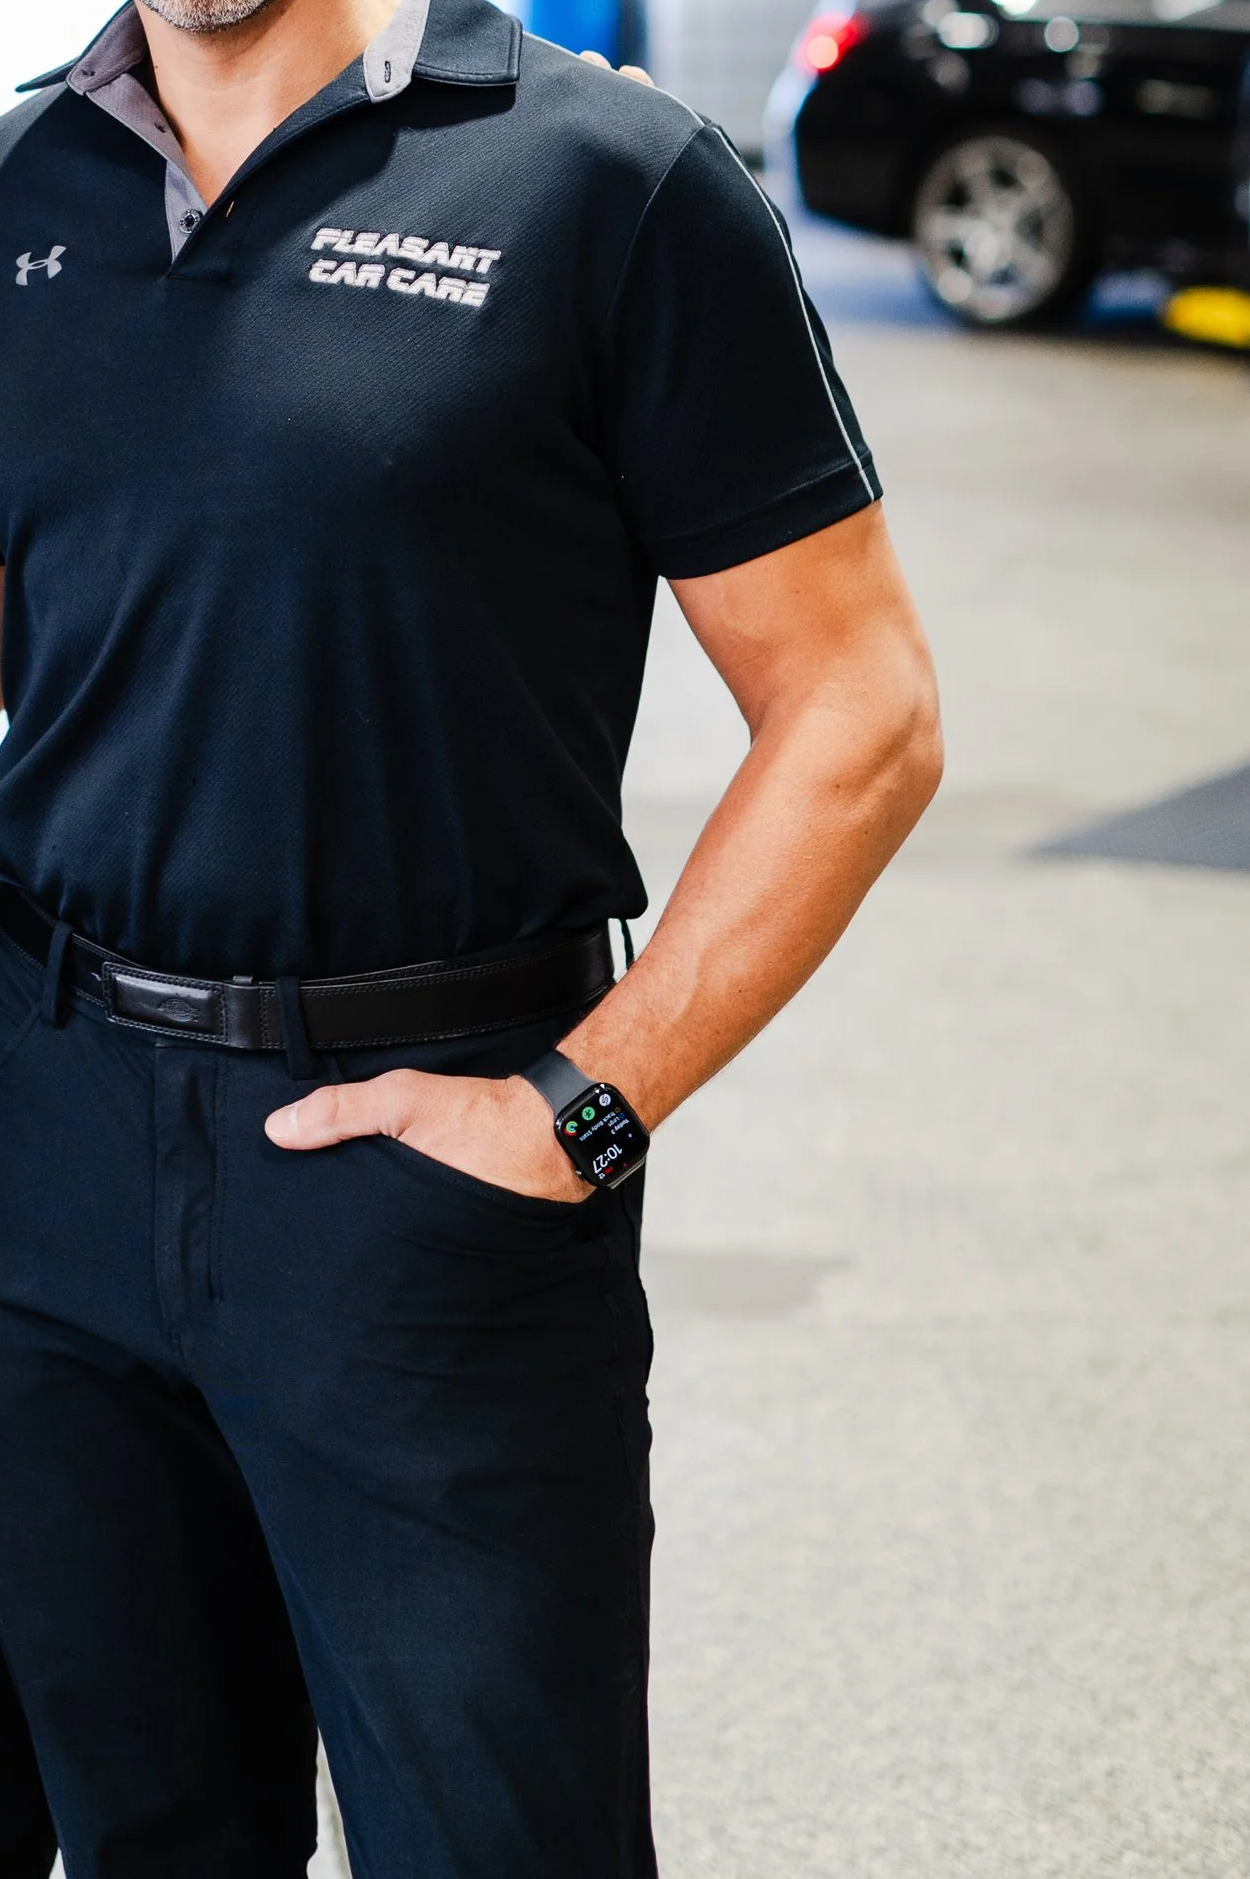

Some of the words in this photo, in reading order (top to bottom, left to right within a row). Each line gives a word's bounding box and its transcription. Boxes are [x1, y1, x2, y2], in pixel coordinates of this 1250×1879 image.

[311, 228, 501, 274] PLEASANT
[308, 259, 386, 288] CAR
[387, 268, 491, 308] CARE
[592, 1144, 623, 1174] 10:27
